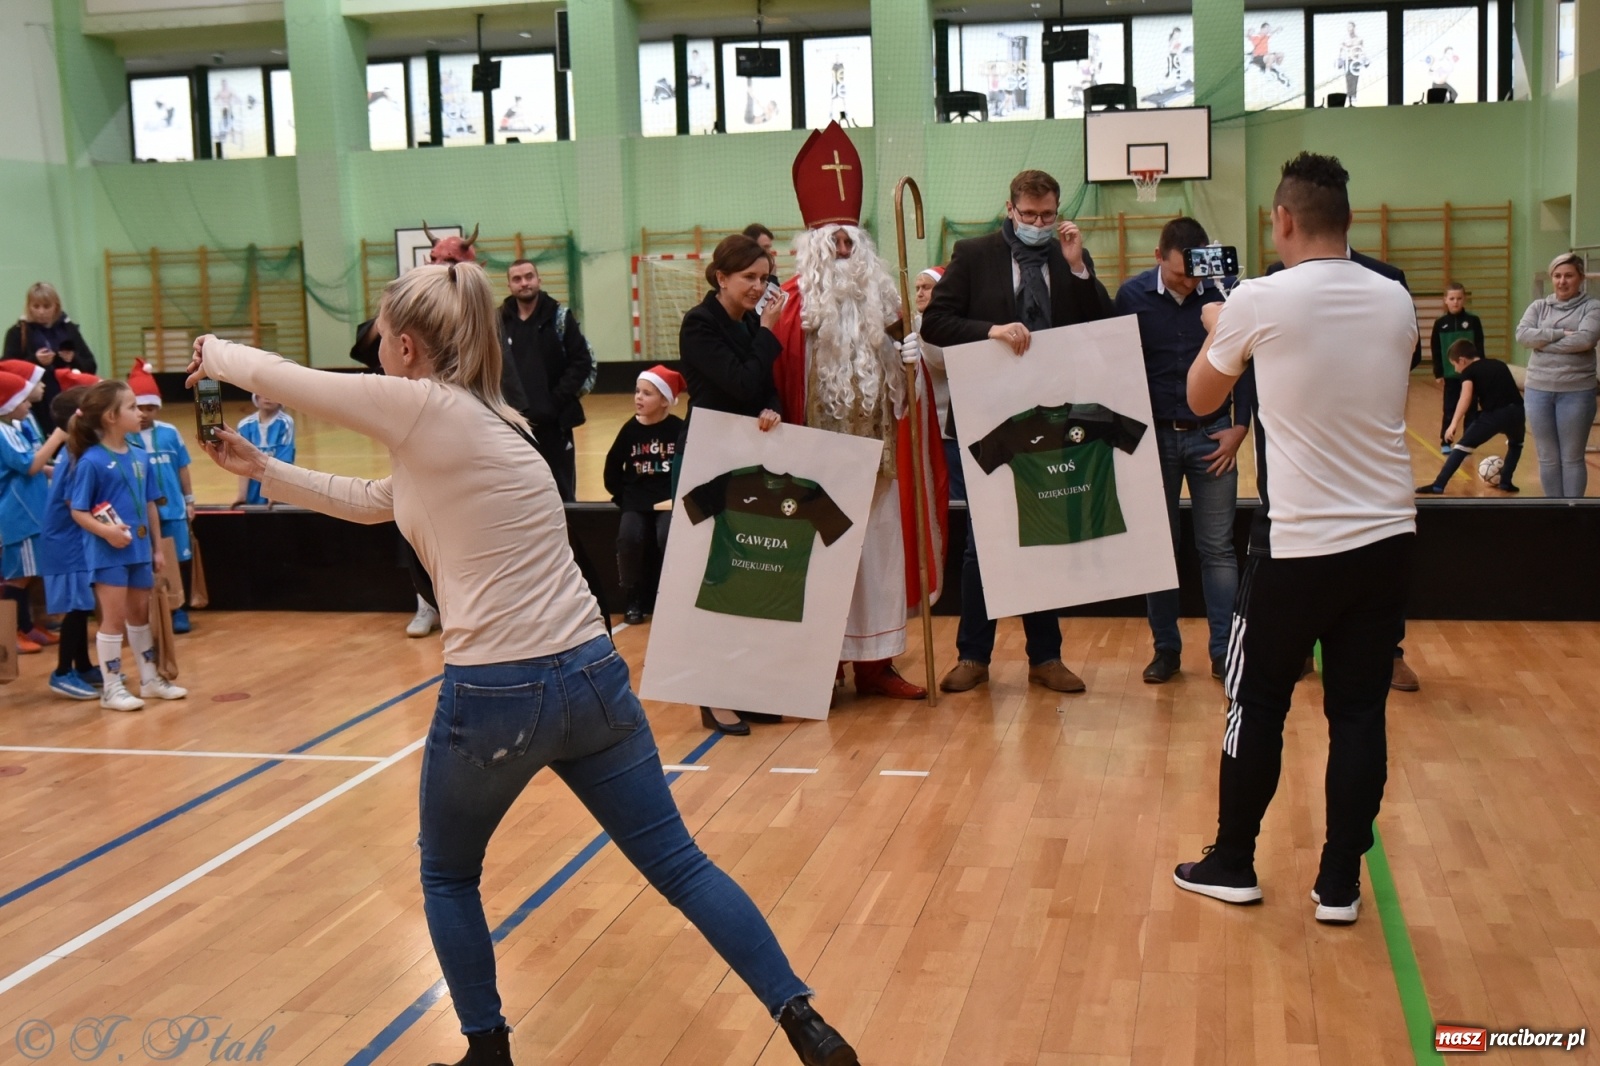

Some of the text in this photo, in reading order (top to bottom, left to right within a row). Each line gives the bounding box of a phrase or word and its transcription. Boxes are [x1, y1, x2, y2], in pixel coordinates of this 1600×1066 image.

[631, 441, 675, 458] JINGLE
[1047, 459, 1076, 475] WOŚ
[1038, 484, 1092, 499] DZIĘKUJEMY
[735, 533, 788, 550] GAWĘDA
[731, 559, 784, 573] DZIĘKUJEMY
